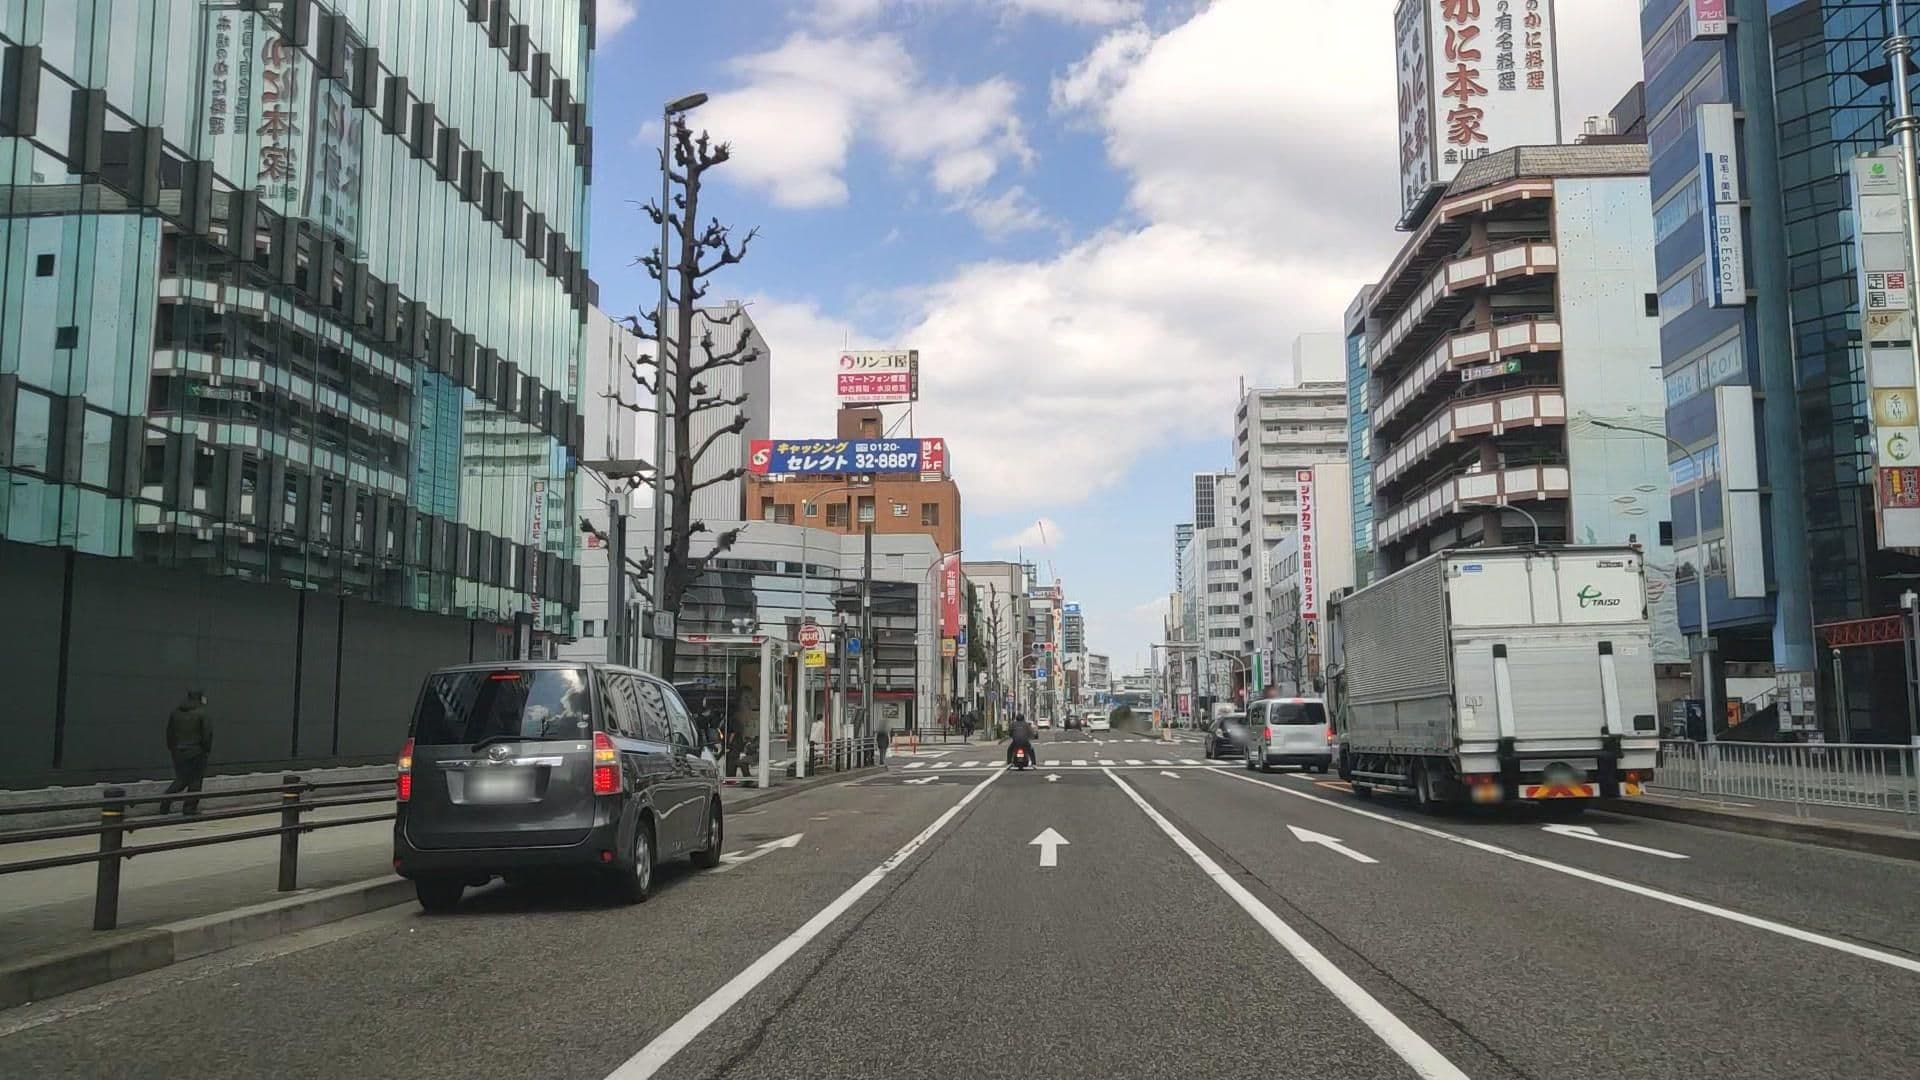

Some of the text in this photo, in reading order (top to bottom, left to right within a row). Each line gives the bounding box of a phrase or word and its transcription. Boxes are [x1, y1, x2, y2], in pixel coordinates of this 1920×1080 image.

[856, 355, 907, 369] リンゴ屋
[776, 442, 849, 455] キャッシング
[786, 455, 849, 471] セレクト
[1300, 485, 1312, 532] ジャンカラ
